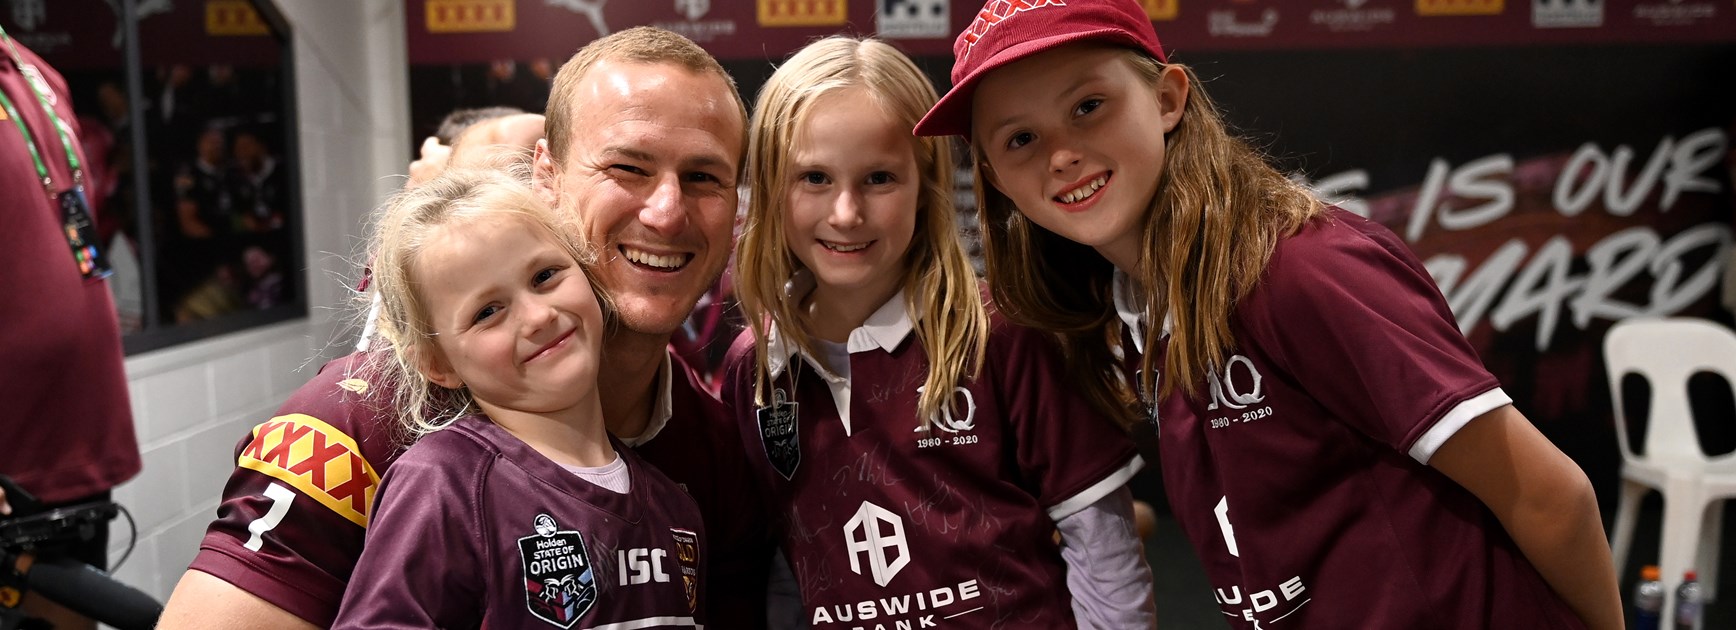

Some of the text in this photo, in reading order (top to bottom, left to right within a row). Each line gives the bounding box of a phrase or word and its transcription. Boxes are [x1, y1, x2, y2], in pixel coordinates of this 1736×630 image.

[1406, 154, 1515, 242] IS
[1553, 127, 1728, 217] OUR
[1242, 406, 1273, 423] 2020
[917, 437, 941, 448] 1980
[953, 434, 978, 445] 2020
[242, 421, 374, 517] XXXX
[243, 482, 297, 552] 7
[533, 545, 575, 560] STATE OF
[536, 538, 567, 550] Holden
[530, 553, 584, 575] ORIGIN
[618, 547, 670, 587] ISC
[812, 578, 981, 626] AUSWIDE
